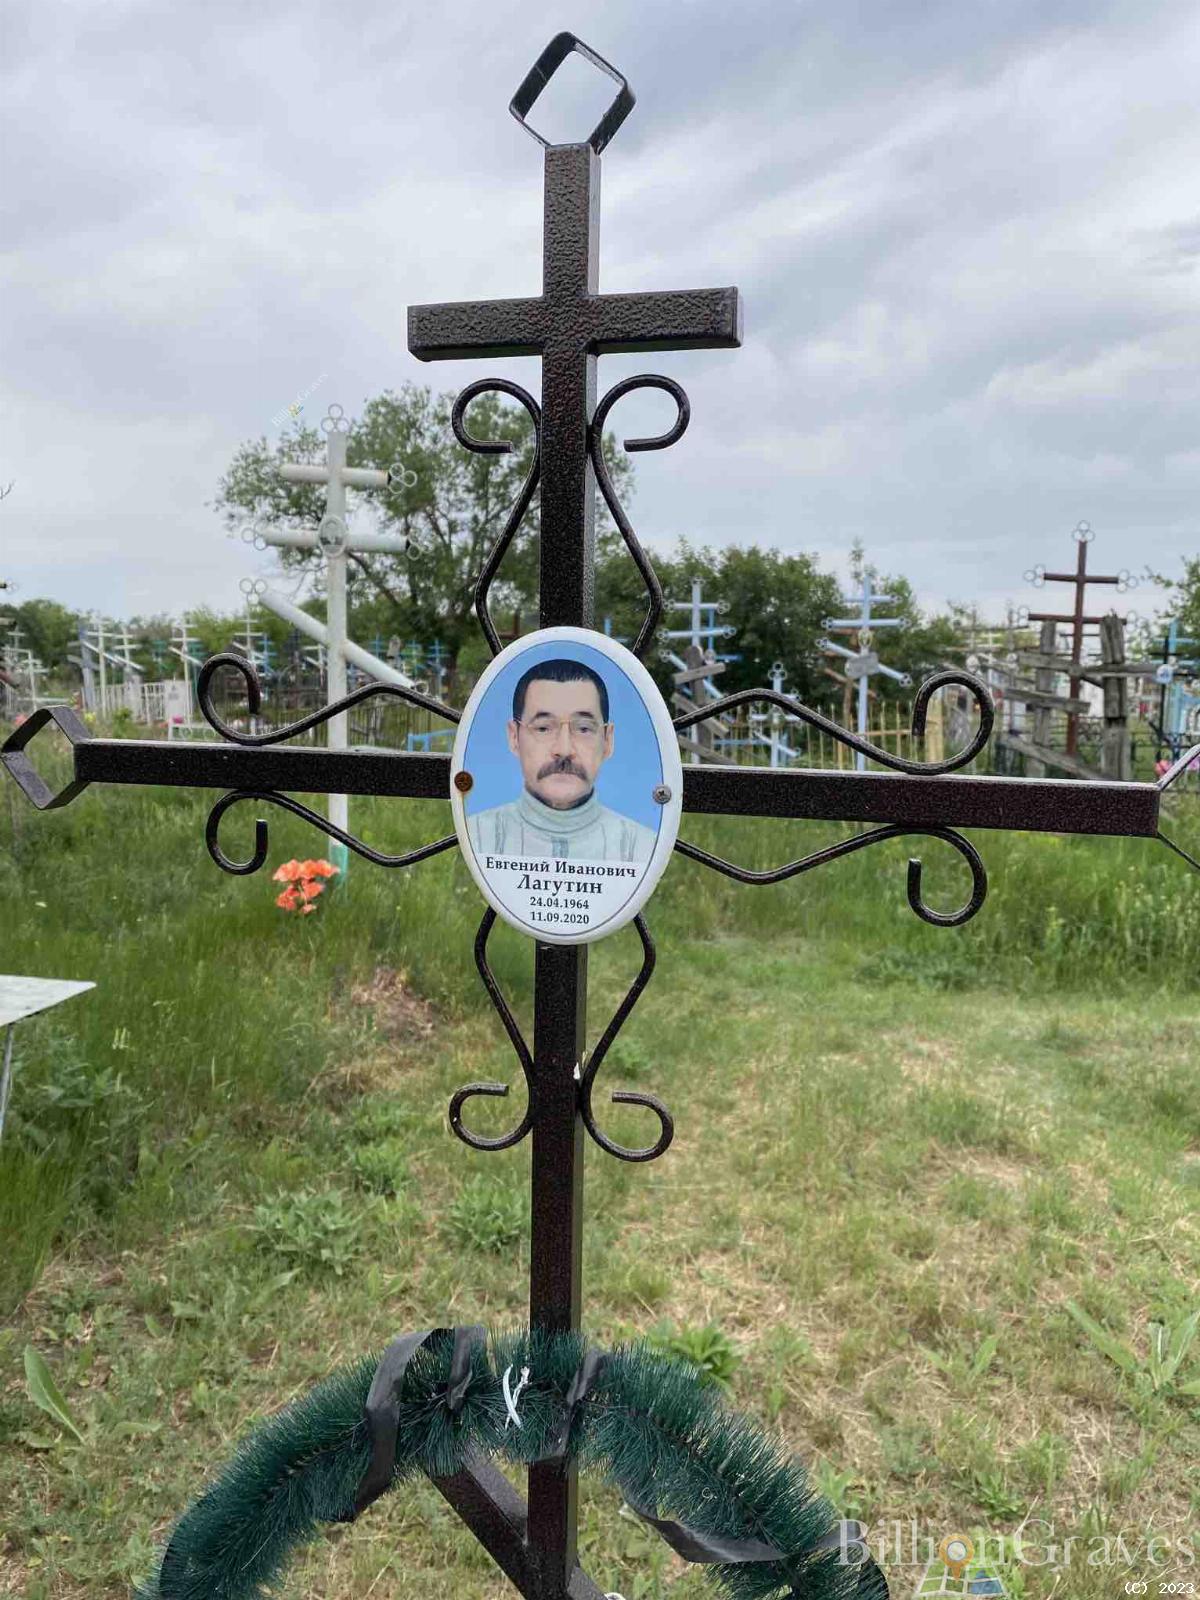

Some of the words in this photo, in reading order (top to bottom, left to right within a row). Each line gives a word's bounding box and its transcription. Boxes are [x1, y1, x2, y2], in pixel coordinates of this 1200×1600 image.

[486, 857, 550, 872] Евгений
[555, 861, 636, 877] Иванович
[517, 874, 602, 896] Лагутин
[530, 897, 589, 909] 24.04.1964
[530, 911, 590, 924] 11.09.2020
